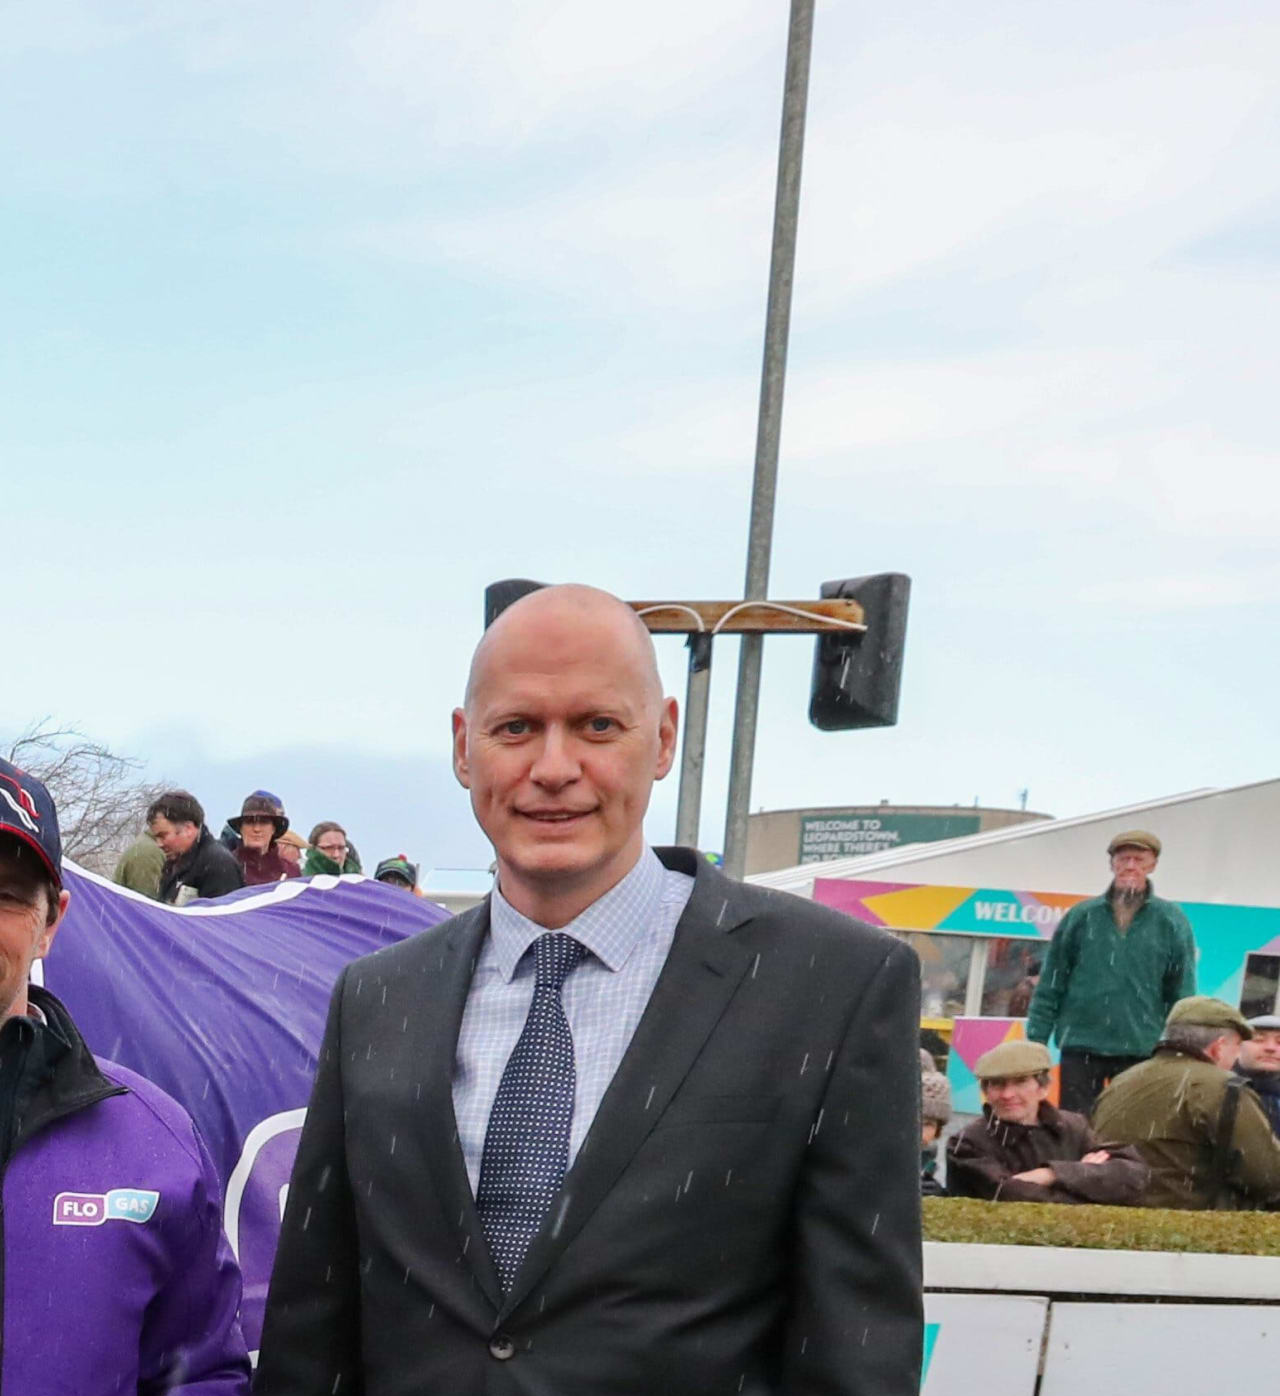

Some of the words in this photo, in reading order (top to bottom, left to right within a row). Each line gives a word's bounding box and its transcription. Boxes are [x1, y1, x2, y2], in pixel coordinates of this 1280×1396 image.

[805, 820, 859, 831] WELCOME
[863, 820, 881, 831] TO
[803, 842, 840, 853] WHERE
[975, 901, 1071, 924] WELCOM
[63, 1201, 98, 1217] FLO
[115, 1197, 149, 1213] GAS
